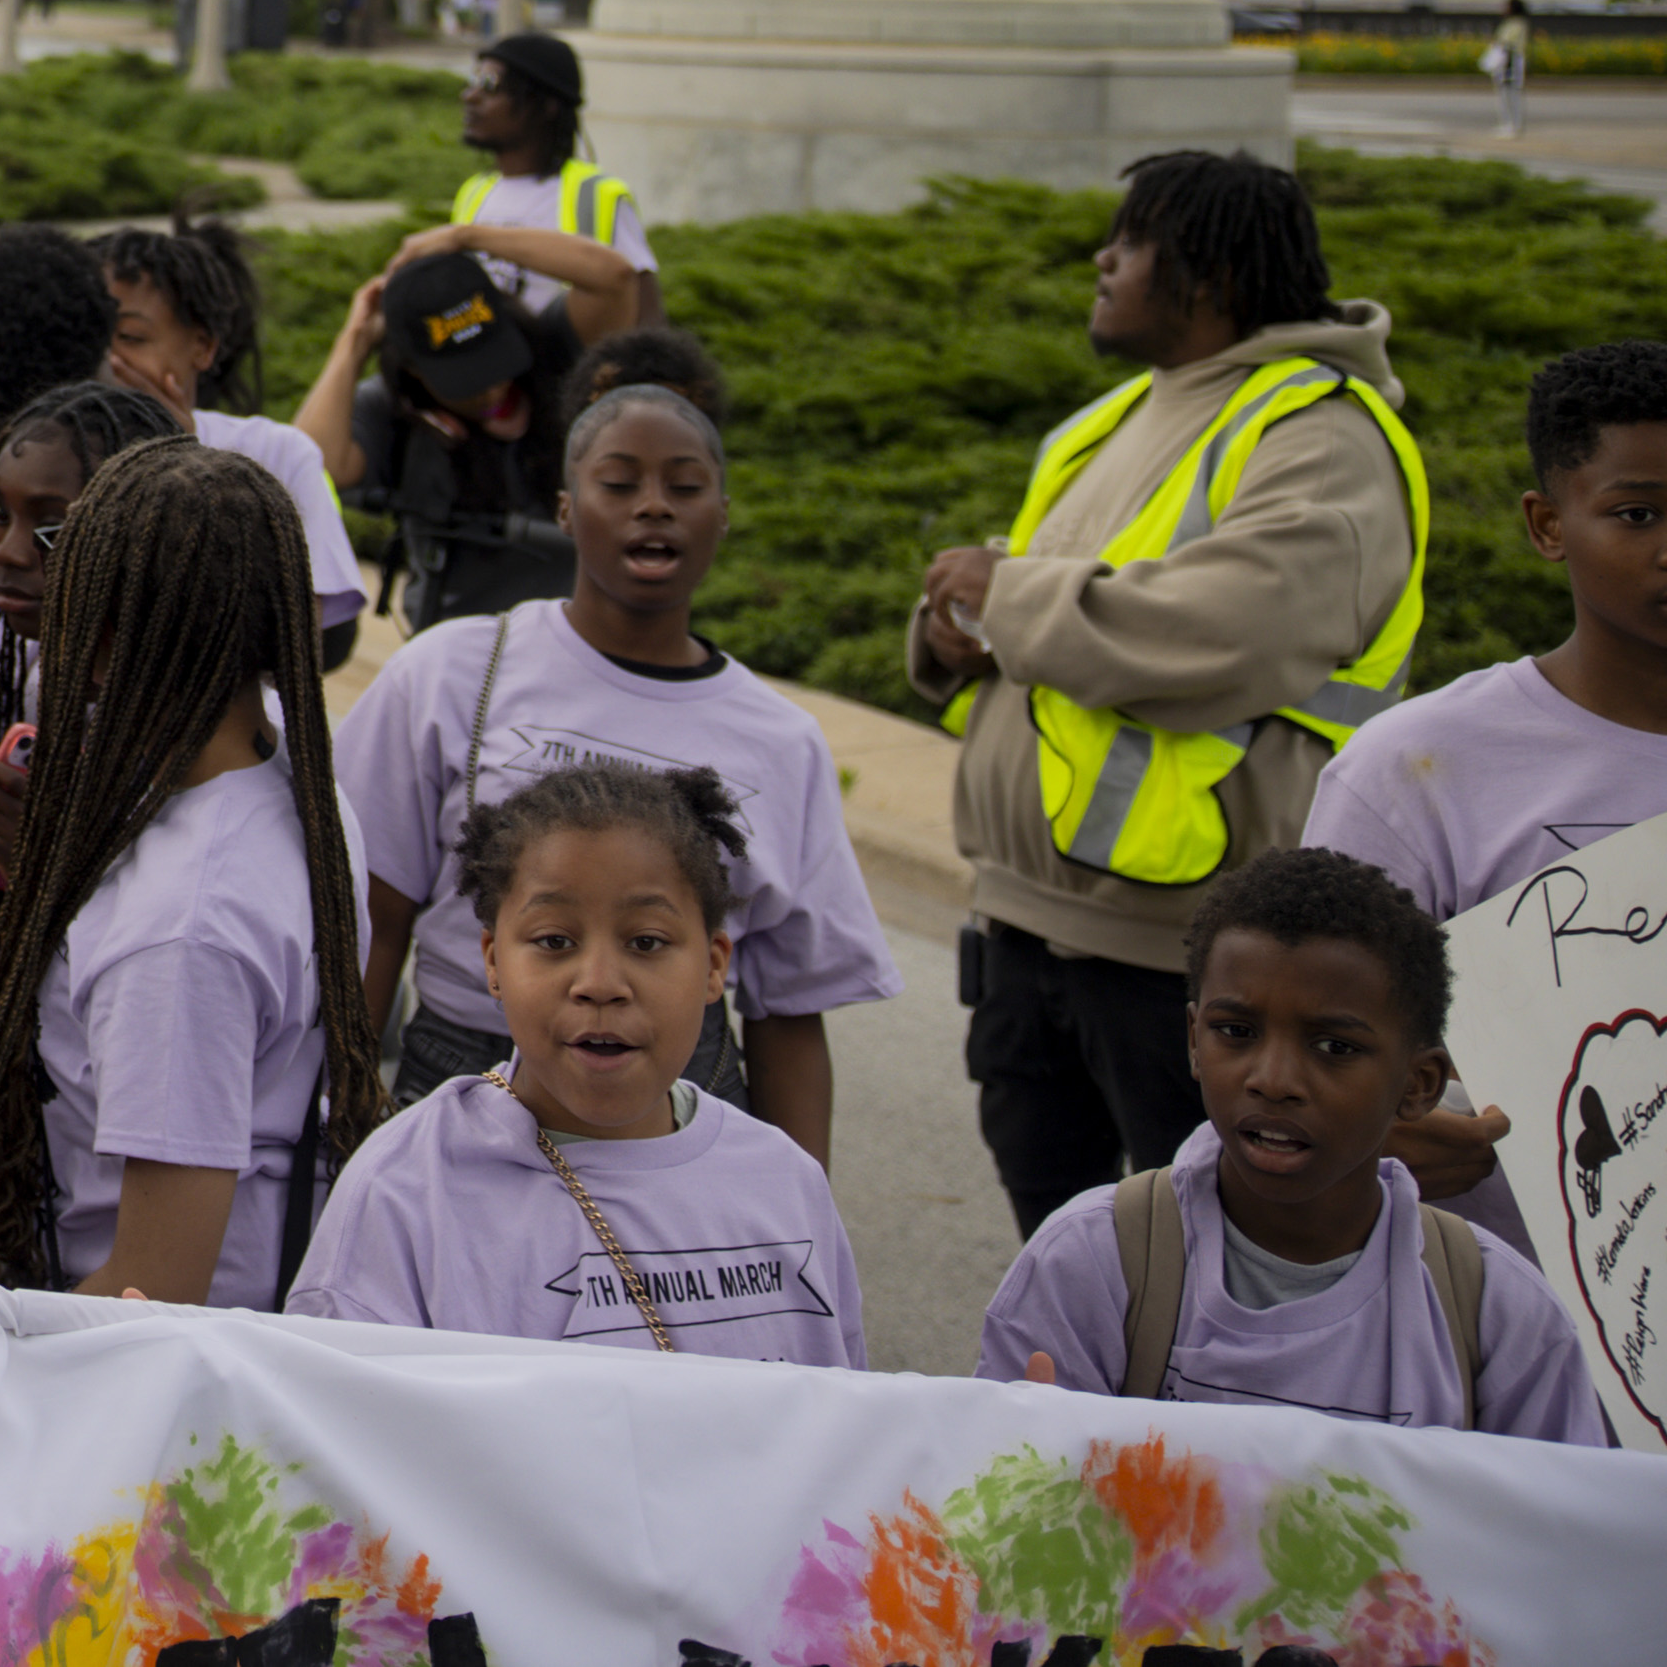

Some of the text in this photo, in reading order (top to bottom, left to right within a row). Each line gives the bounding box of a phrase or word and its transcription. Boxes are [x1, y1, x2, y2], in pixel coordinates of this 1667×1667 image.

[542, 740, 576, 764] 7TH
[586, 1274, 619, 1309] TH
[717, 1260, 783, 1300] MARCH
